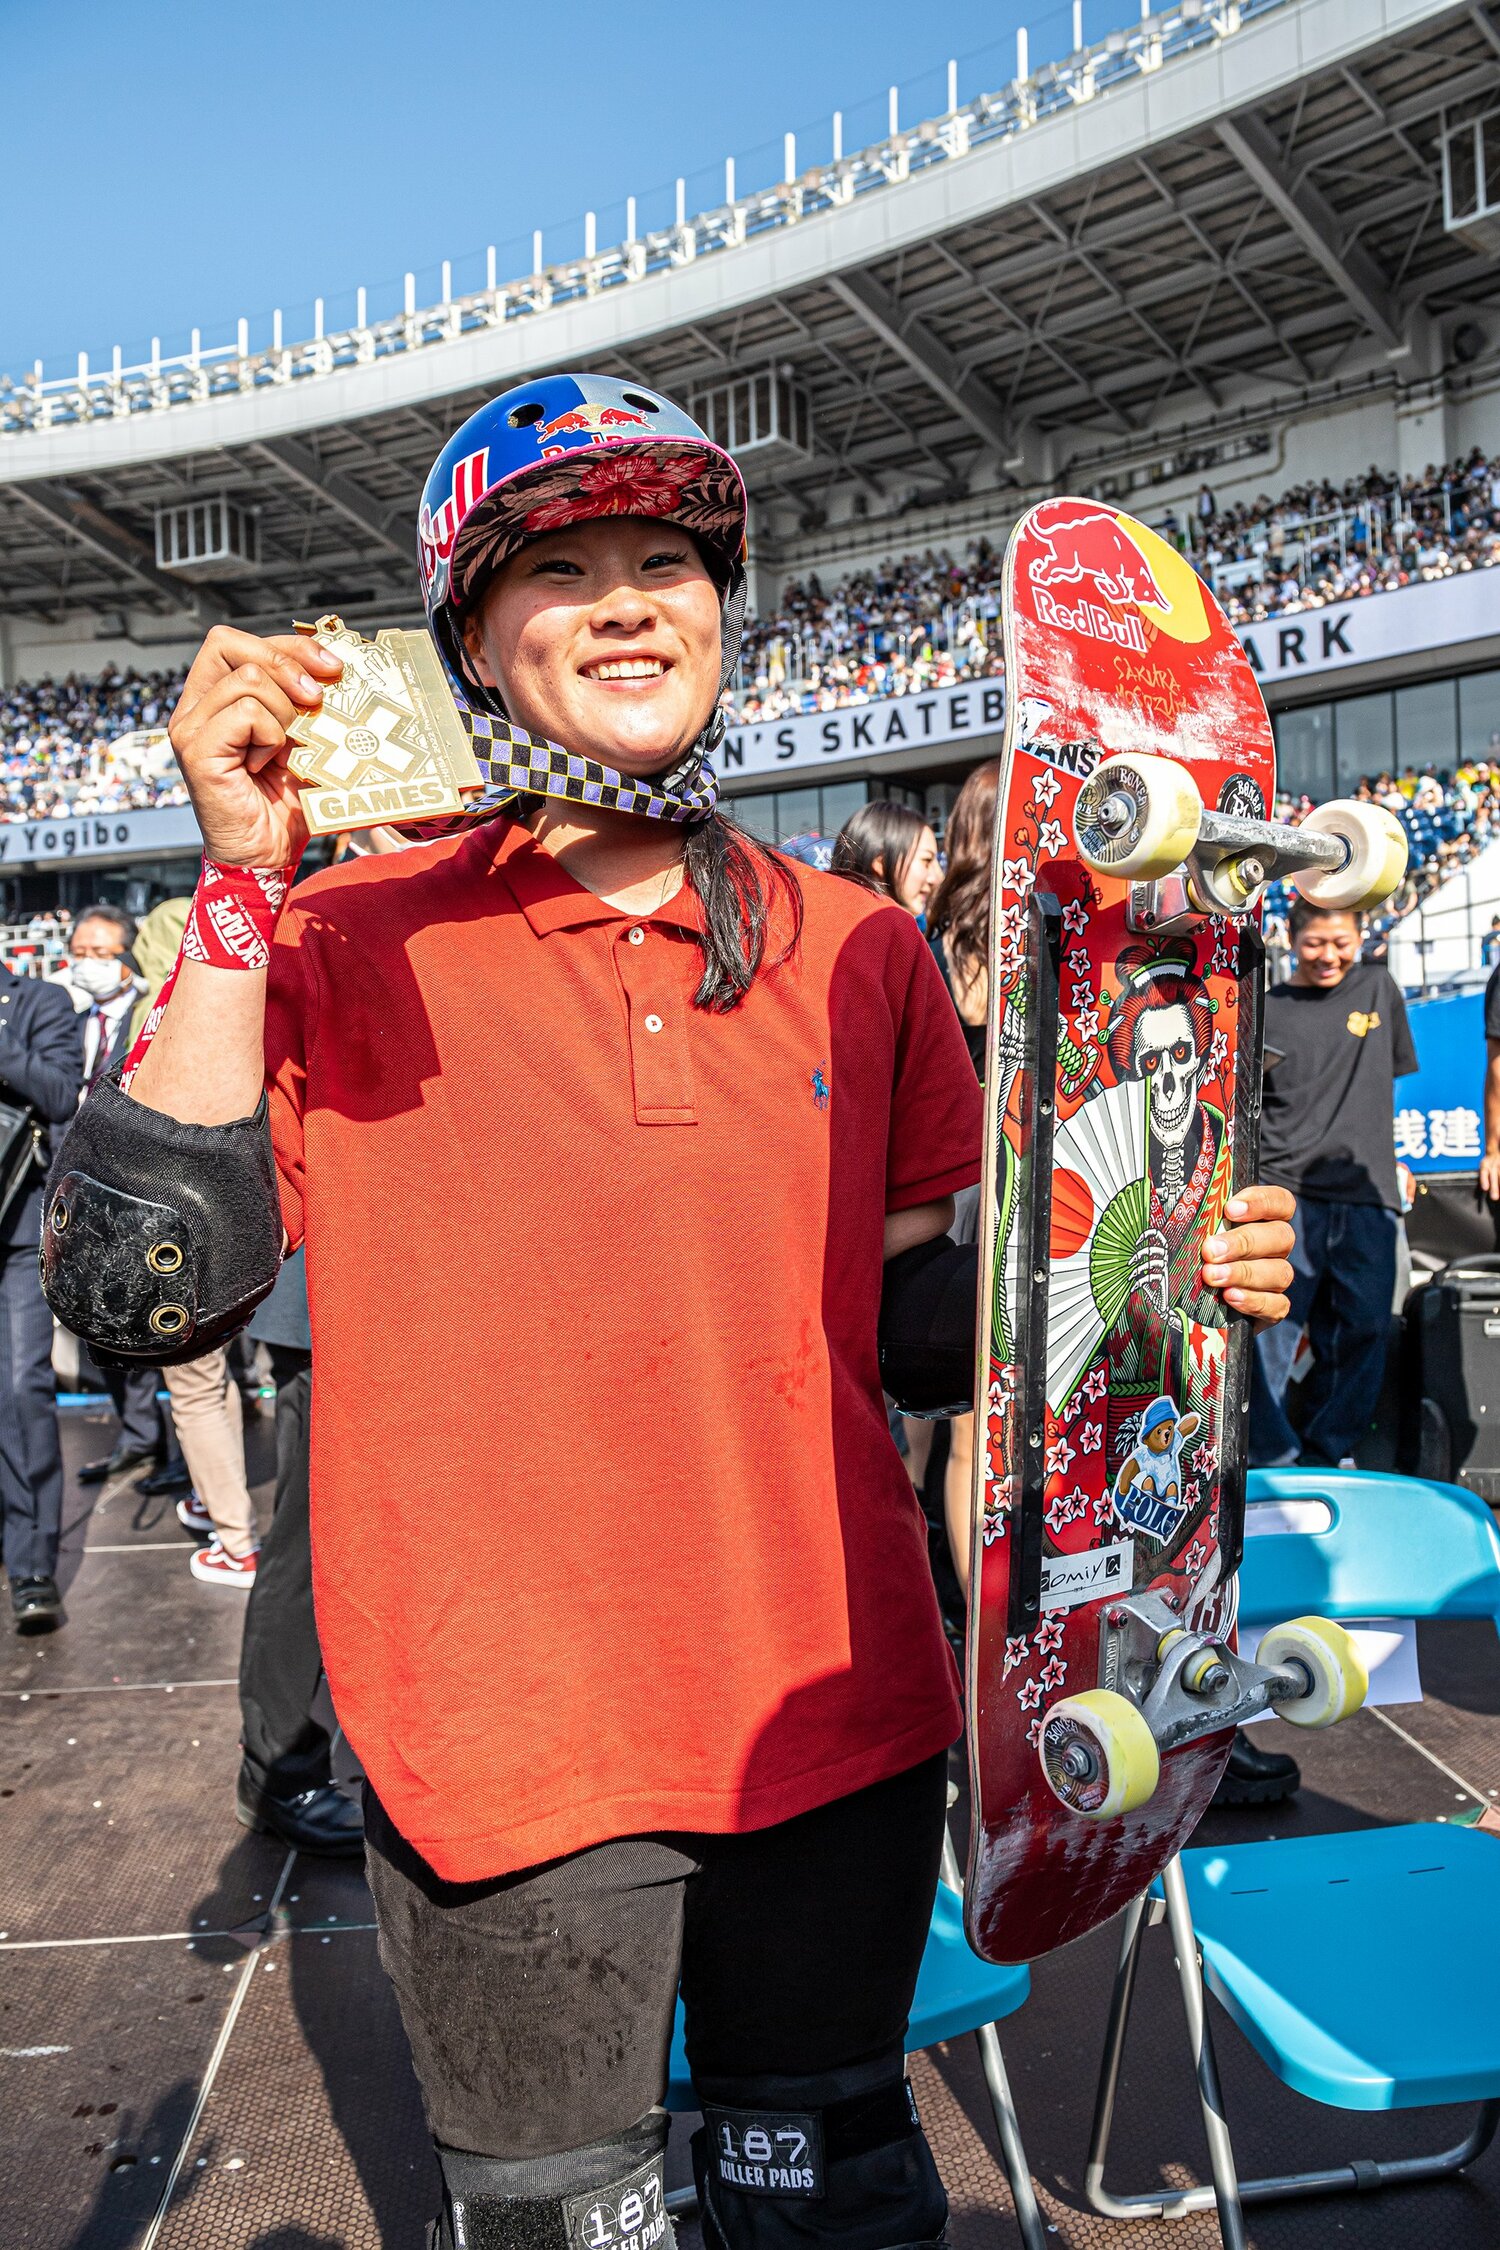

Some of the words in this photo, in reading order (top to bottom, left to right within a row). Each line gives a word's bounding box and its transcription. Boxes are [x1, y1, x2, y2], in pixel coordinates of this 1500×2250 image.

[318, 781, 445, 821] GAMES
[23, 820, 130, 856] Yogibo
[722, 2126, 807, 2163] 187
[719, 2159, 766, 2187] KILLER
[769, 2168, 815, 2188] PADS
[590, 2175, 661, 2247] 187
